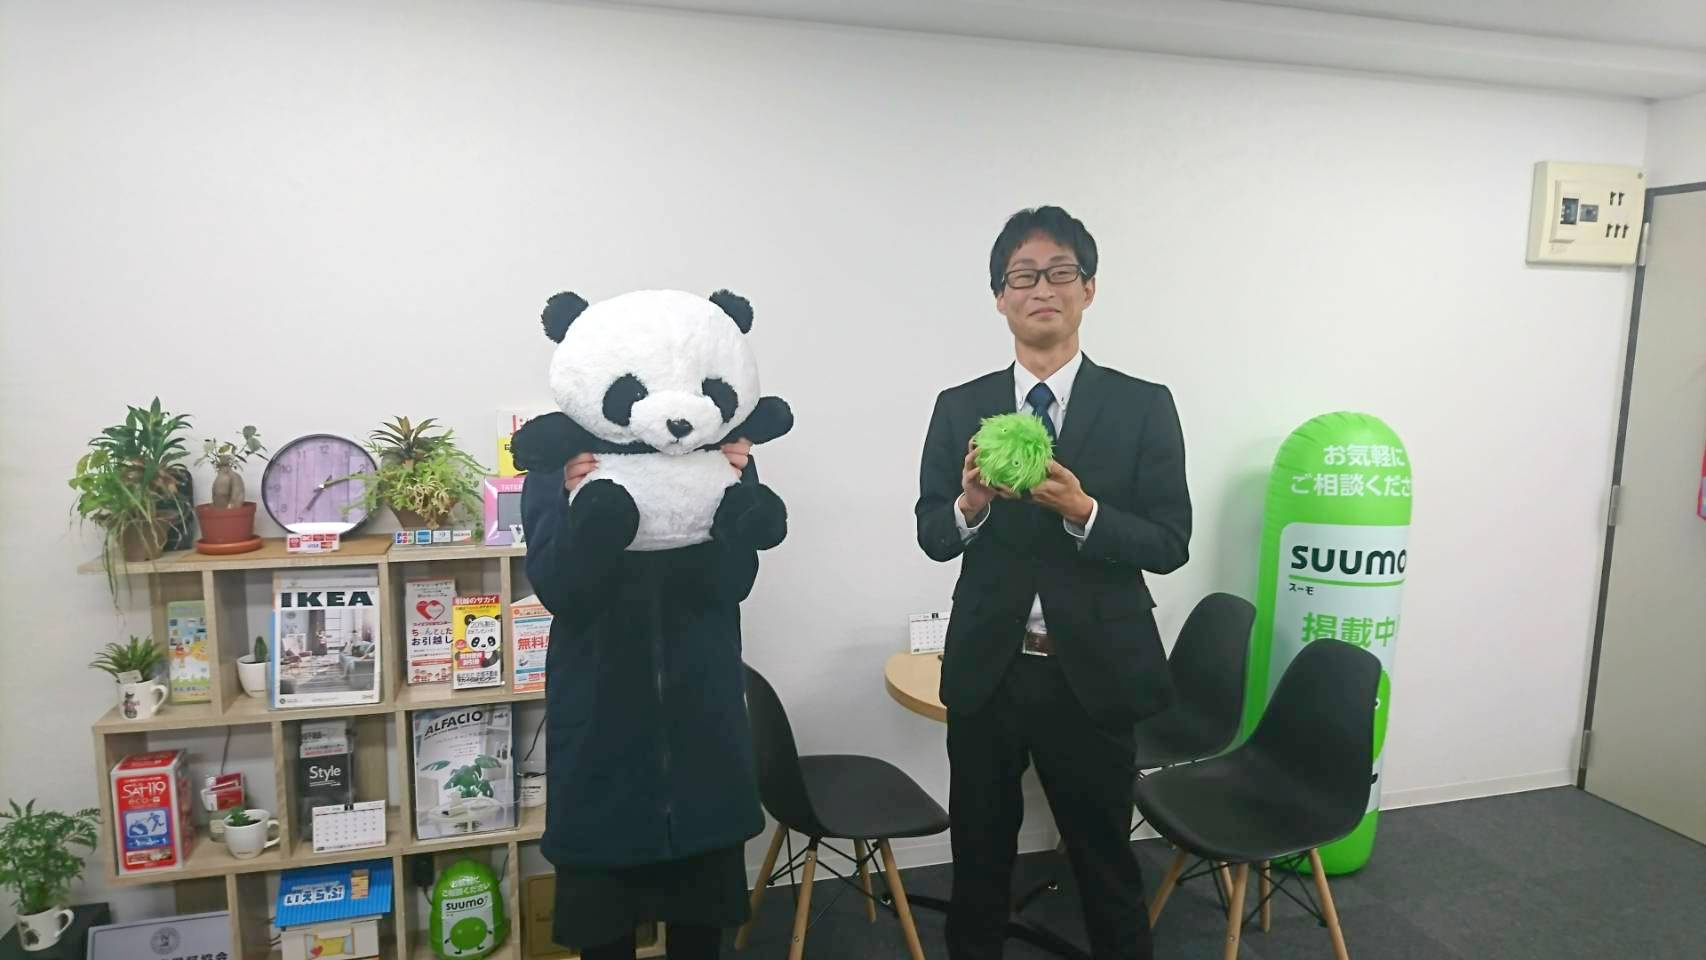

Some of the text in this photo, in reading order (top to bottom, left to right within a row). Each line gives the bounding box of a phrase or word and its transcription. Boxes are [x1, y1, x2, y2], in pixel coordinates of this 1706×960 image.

[1323, 444, 1405, 467] お気軽に
[1288, 582, 1315, 596] スーモ
[281, 591, 374, 608] IKEA
[424, 710, 483, 736] ALFACIO
[309, 764, 341, 781] Style
